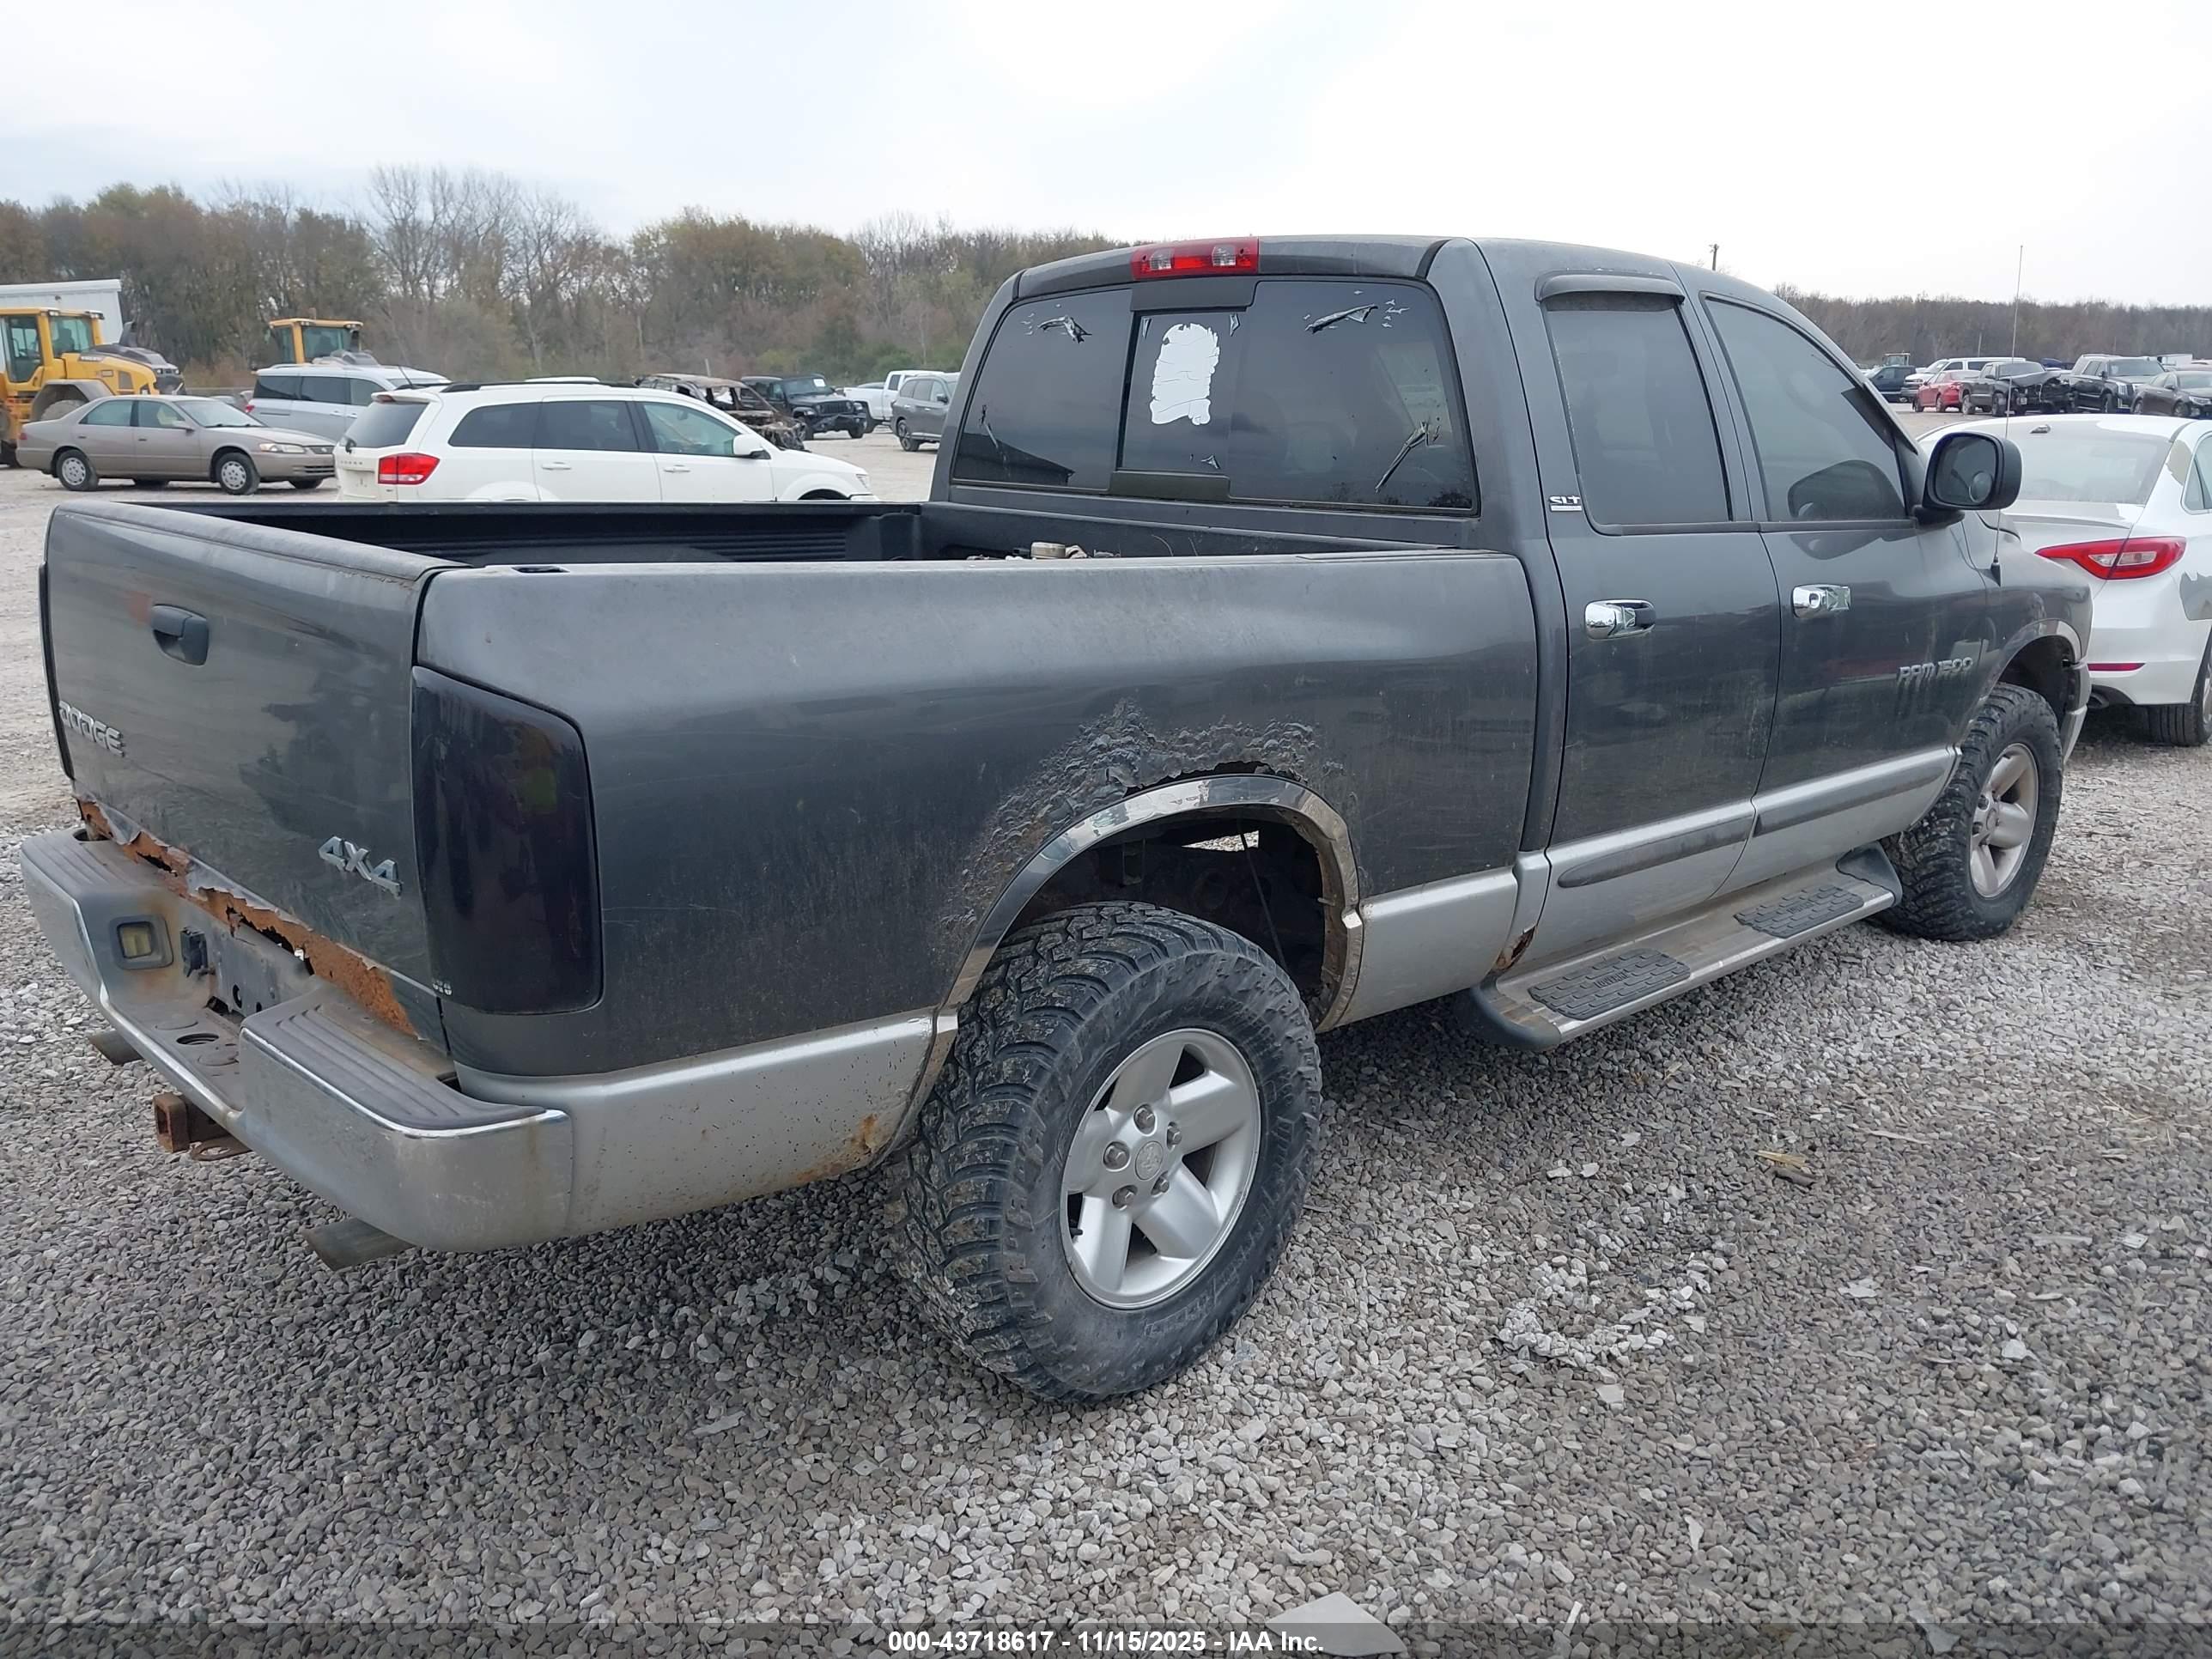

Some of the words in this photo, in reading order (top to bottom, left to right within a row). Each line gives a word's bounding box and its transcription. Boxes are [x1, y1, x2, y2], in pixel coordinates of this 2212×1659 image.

[1549, 495, 1581, 505] SLT
[1897, 662, 1936, 687] RAM
[1936, 656, 1973, 680] 1500
[58, 700, 125, 757] DODGE
